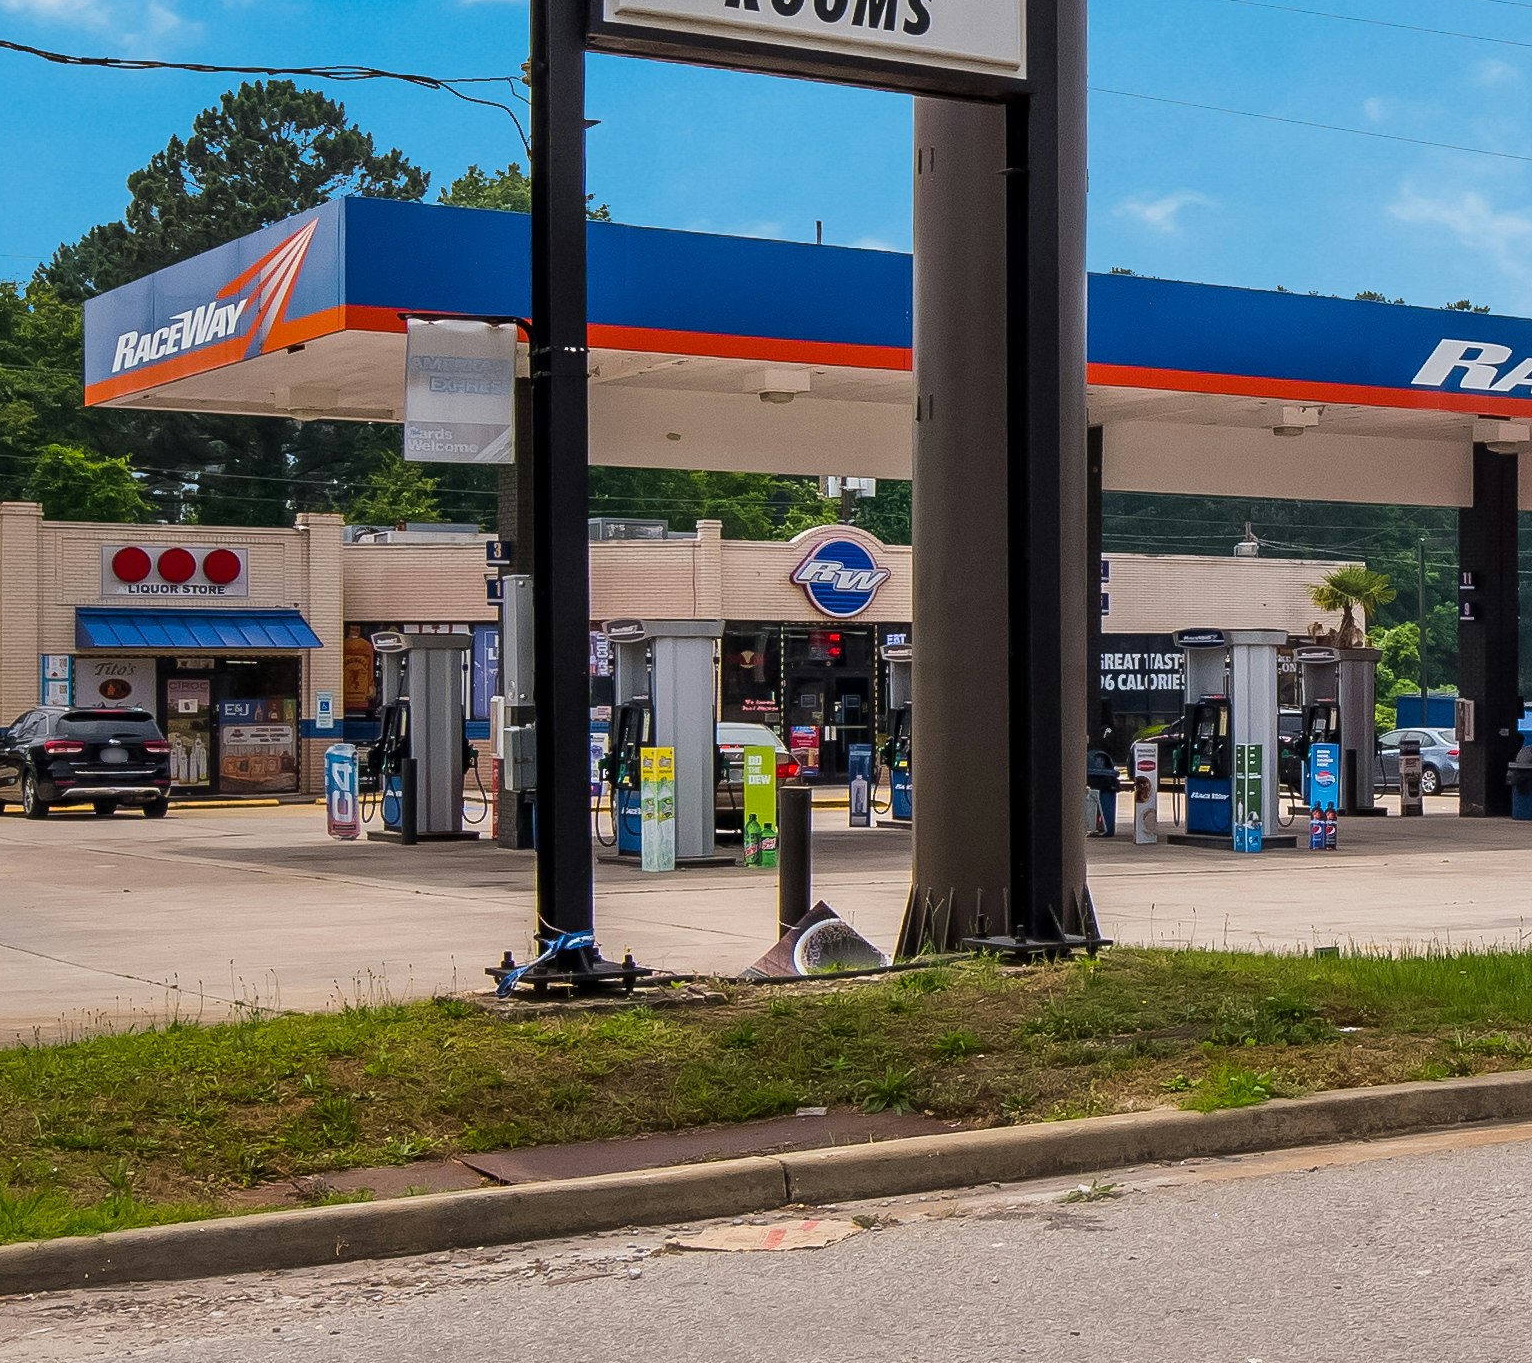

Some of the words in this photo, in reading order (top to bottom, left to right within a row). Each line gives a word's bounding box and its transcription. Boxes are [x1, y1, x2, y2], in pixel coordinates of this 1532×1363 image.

[408, 426, 453, 440] Cards
[408, 439, 479, 453] Welcome
[493, 542, 502, 558] 3
[798, 560, 886, 590] RW
[128, 584, 179, 595] LIQUOR
[183, 584, 226, 595] STORE
[95, 662, 136, 675] Tito's
[224, 703, 250, 716] E&J
[748, 774, 771, 785] DEW
